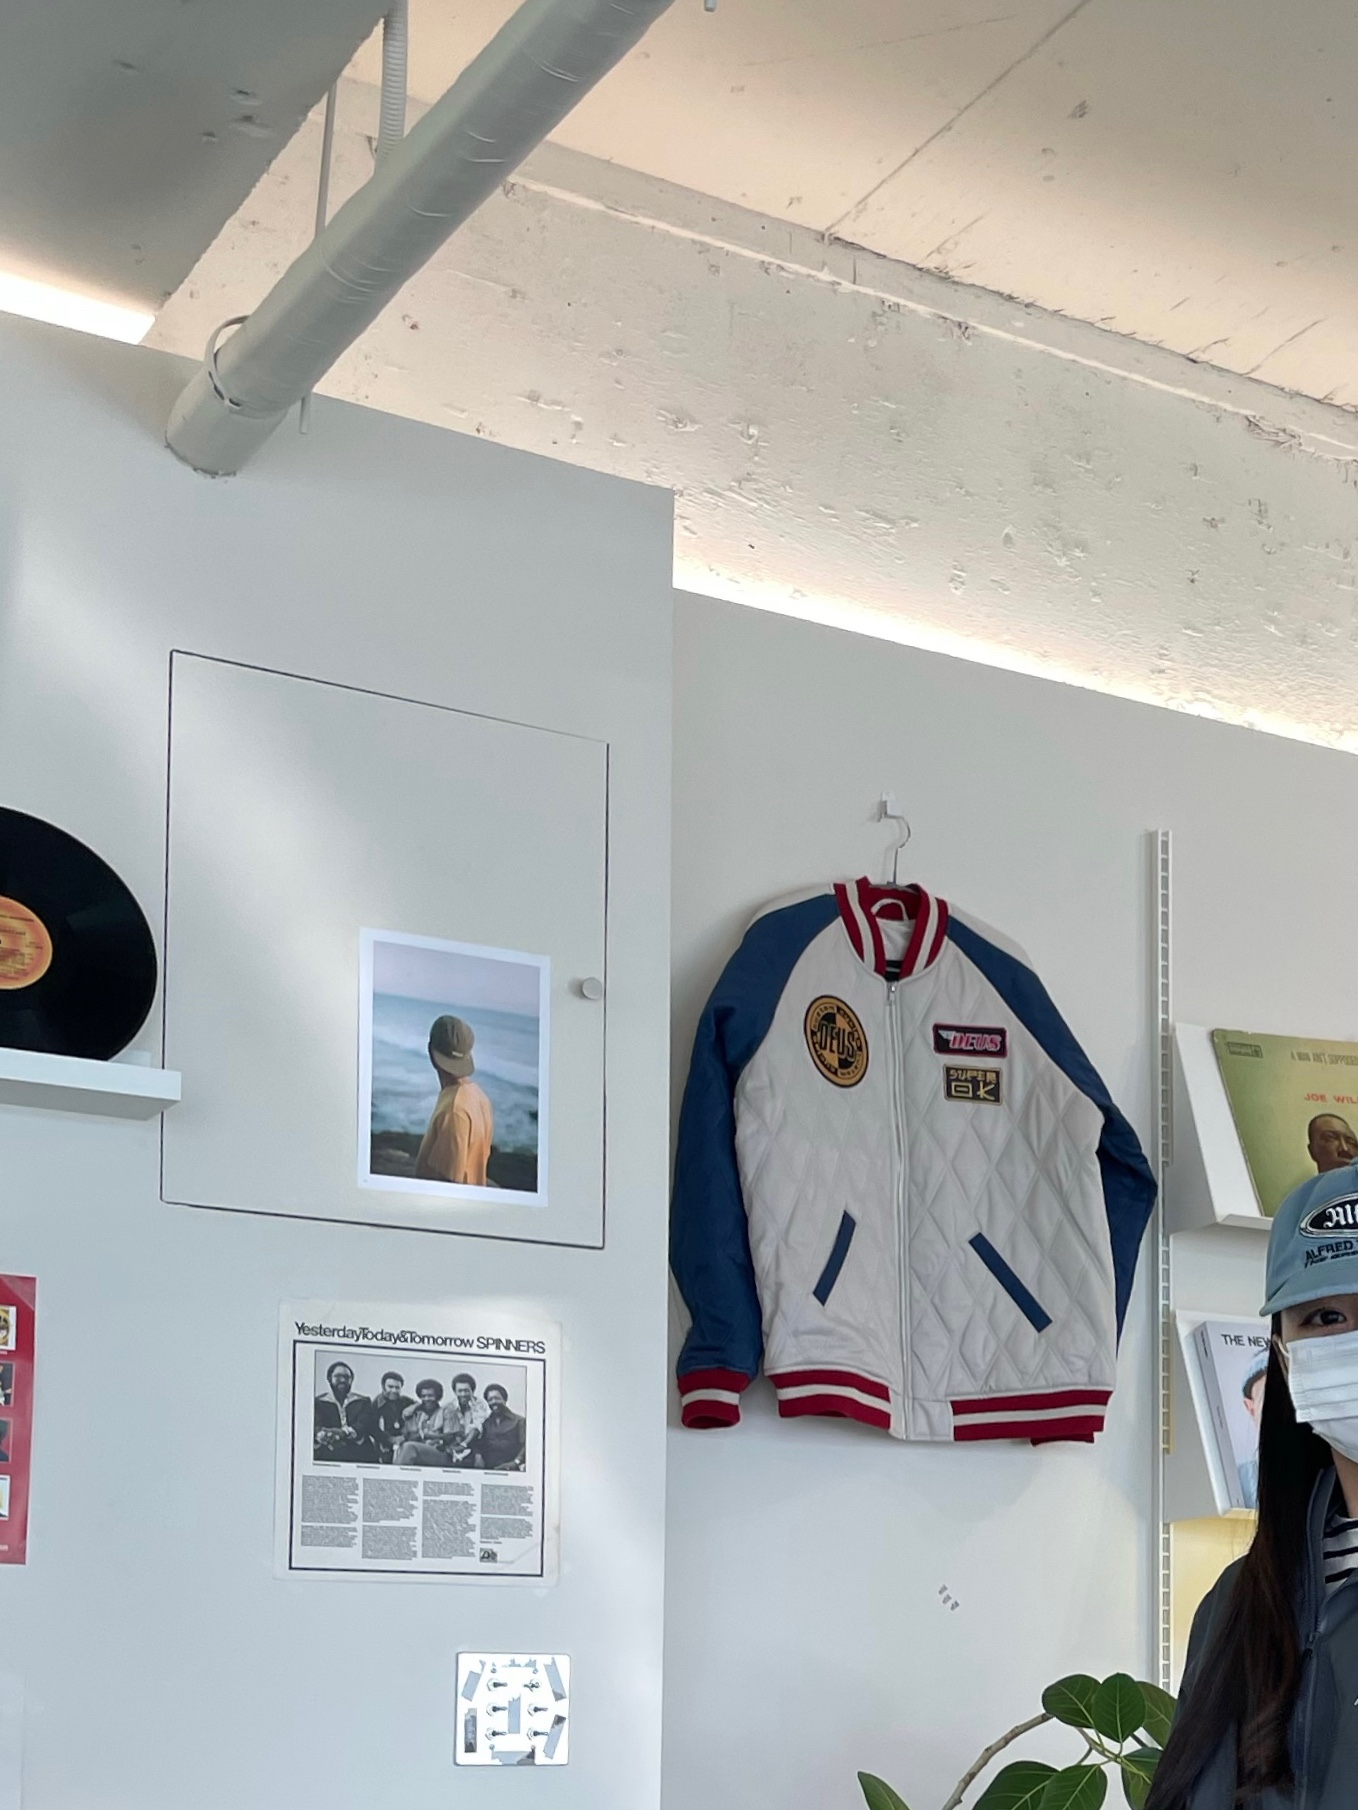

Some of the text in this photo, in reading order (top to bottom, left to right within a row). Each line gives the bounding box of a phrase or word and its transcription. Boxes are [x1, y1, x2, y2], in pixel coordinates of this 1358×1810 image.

[817, 1020, 856, 1062] DEUS
[949, 1032, 1001, 1051] DEUS
[949, 1069, 997, 1084] SUPER
[1304, 1092, 1327, 1102] JOE
[1305, 1240, 1354, 1261] ALFRED
[476, 1336, 546, 1354] SPINNERS
[1221, 1333, 1246, 1347] THE
